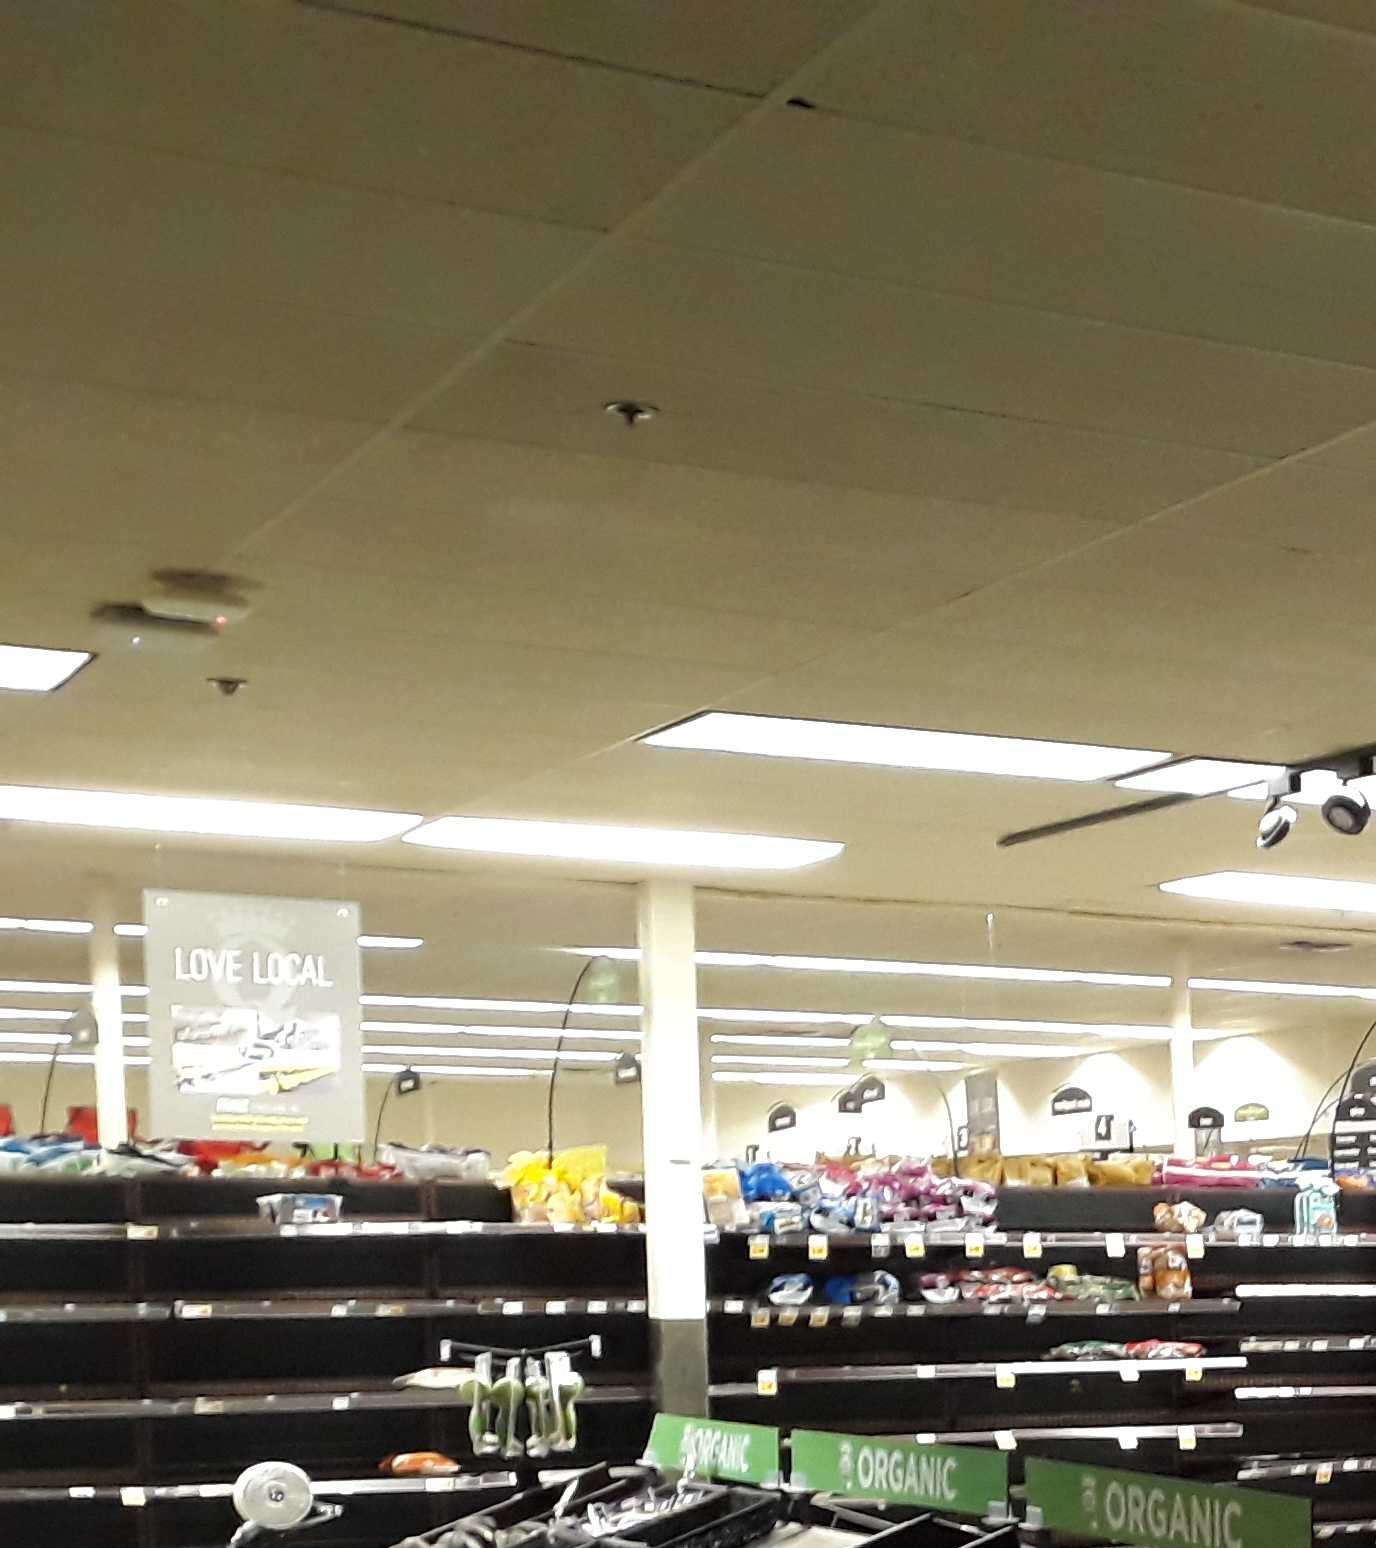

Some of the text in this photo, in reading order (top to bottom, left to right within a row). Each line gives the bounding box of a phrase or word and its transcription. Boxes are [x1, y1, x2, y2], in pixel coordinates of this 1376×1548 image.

[175, 947, 333, 987] LOVE LOCAL
[694, 1428, 750, 1472] ORGANIC
[857, 1446, 957, 1499] ORGANIC
